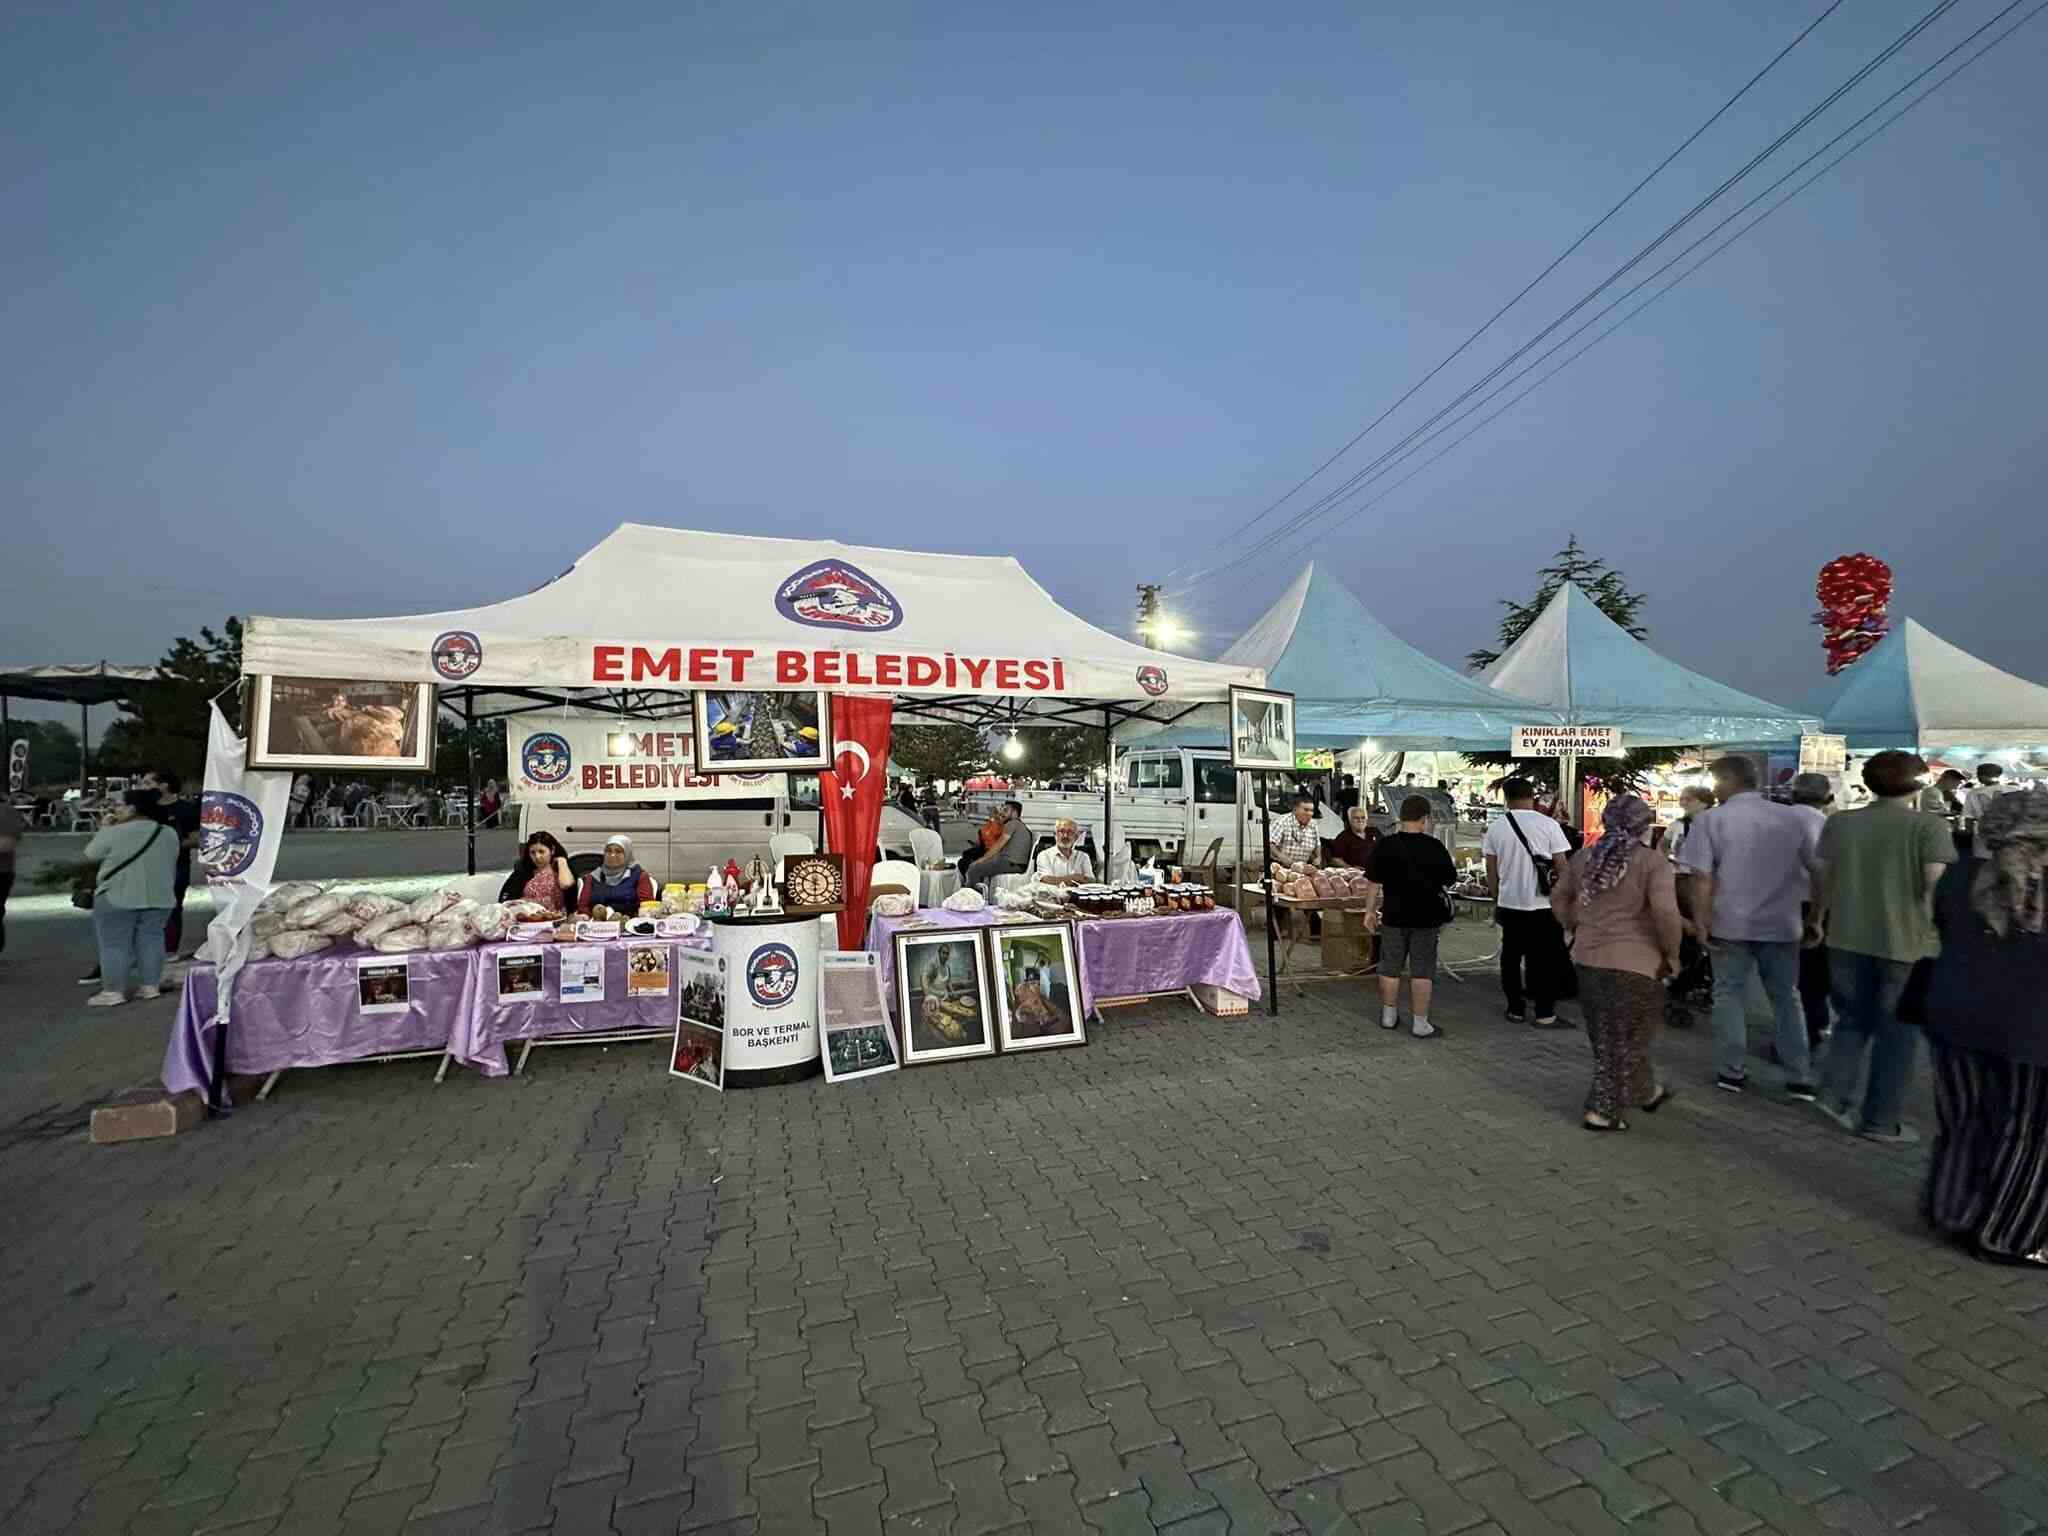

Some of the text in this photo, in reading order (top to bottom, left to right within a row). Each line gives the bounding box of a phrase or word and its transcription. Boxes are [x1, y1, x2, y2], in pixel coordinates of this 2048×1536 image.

[592, 646, 1065, 692] EMET BELEDİYESİ
[1521, 727, 1611, 737] KINIKLAR EMET
[1523, 738, 1610, 747] EV TARHANASI
[732, 1020, 811, 1037] BOR VE TERMAL
[747, 1032, 799, 1047] BAŞKENTİ
